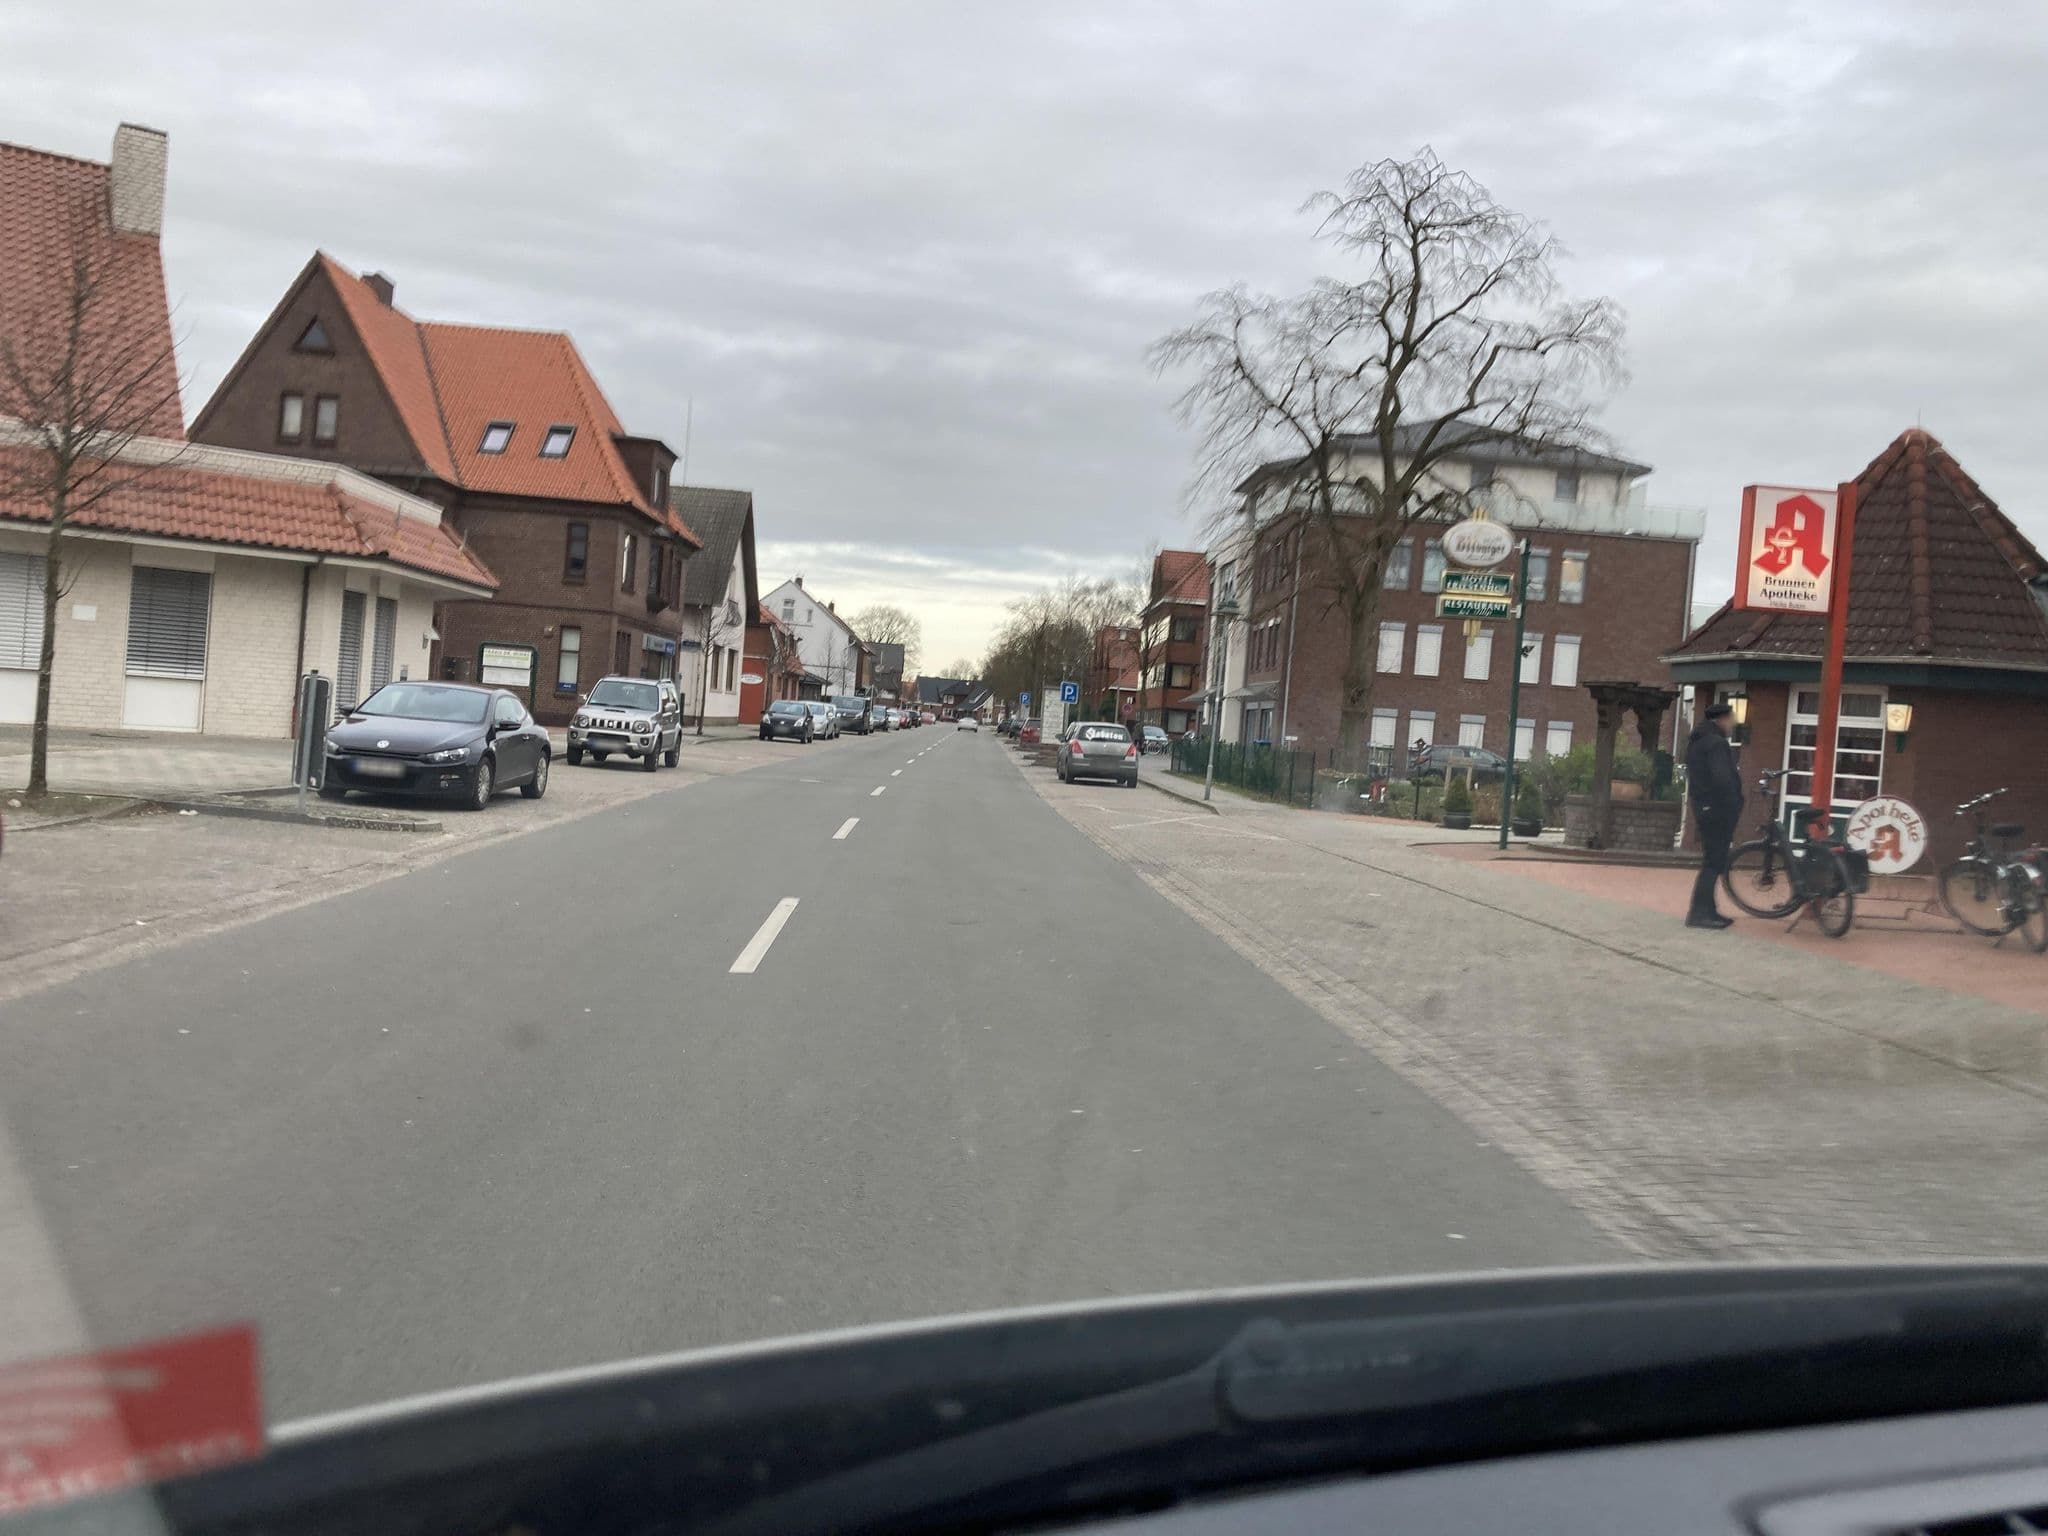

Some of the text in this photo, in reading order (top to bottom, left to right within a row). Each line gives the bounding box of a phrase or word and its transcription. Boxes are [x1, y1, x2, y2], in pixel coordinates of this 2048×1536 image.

[1765, 576, 1816, 589] Brunnen
[1760, 588, 1818, 602] Apotheke
[1444, 600, 1507, 611] RESTAURANT
[1064, 685, 1074, 701] P
[1848, 803, 1921, 843] Apotheke
